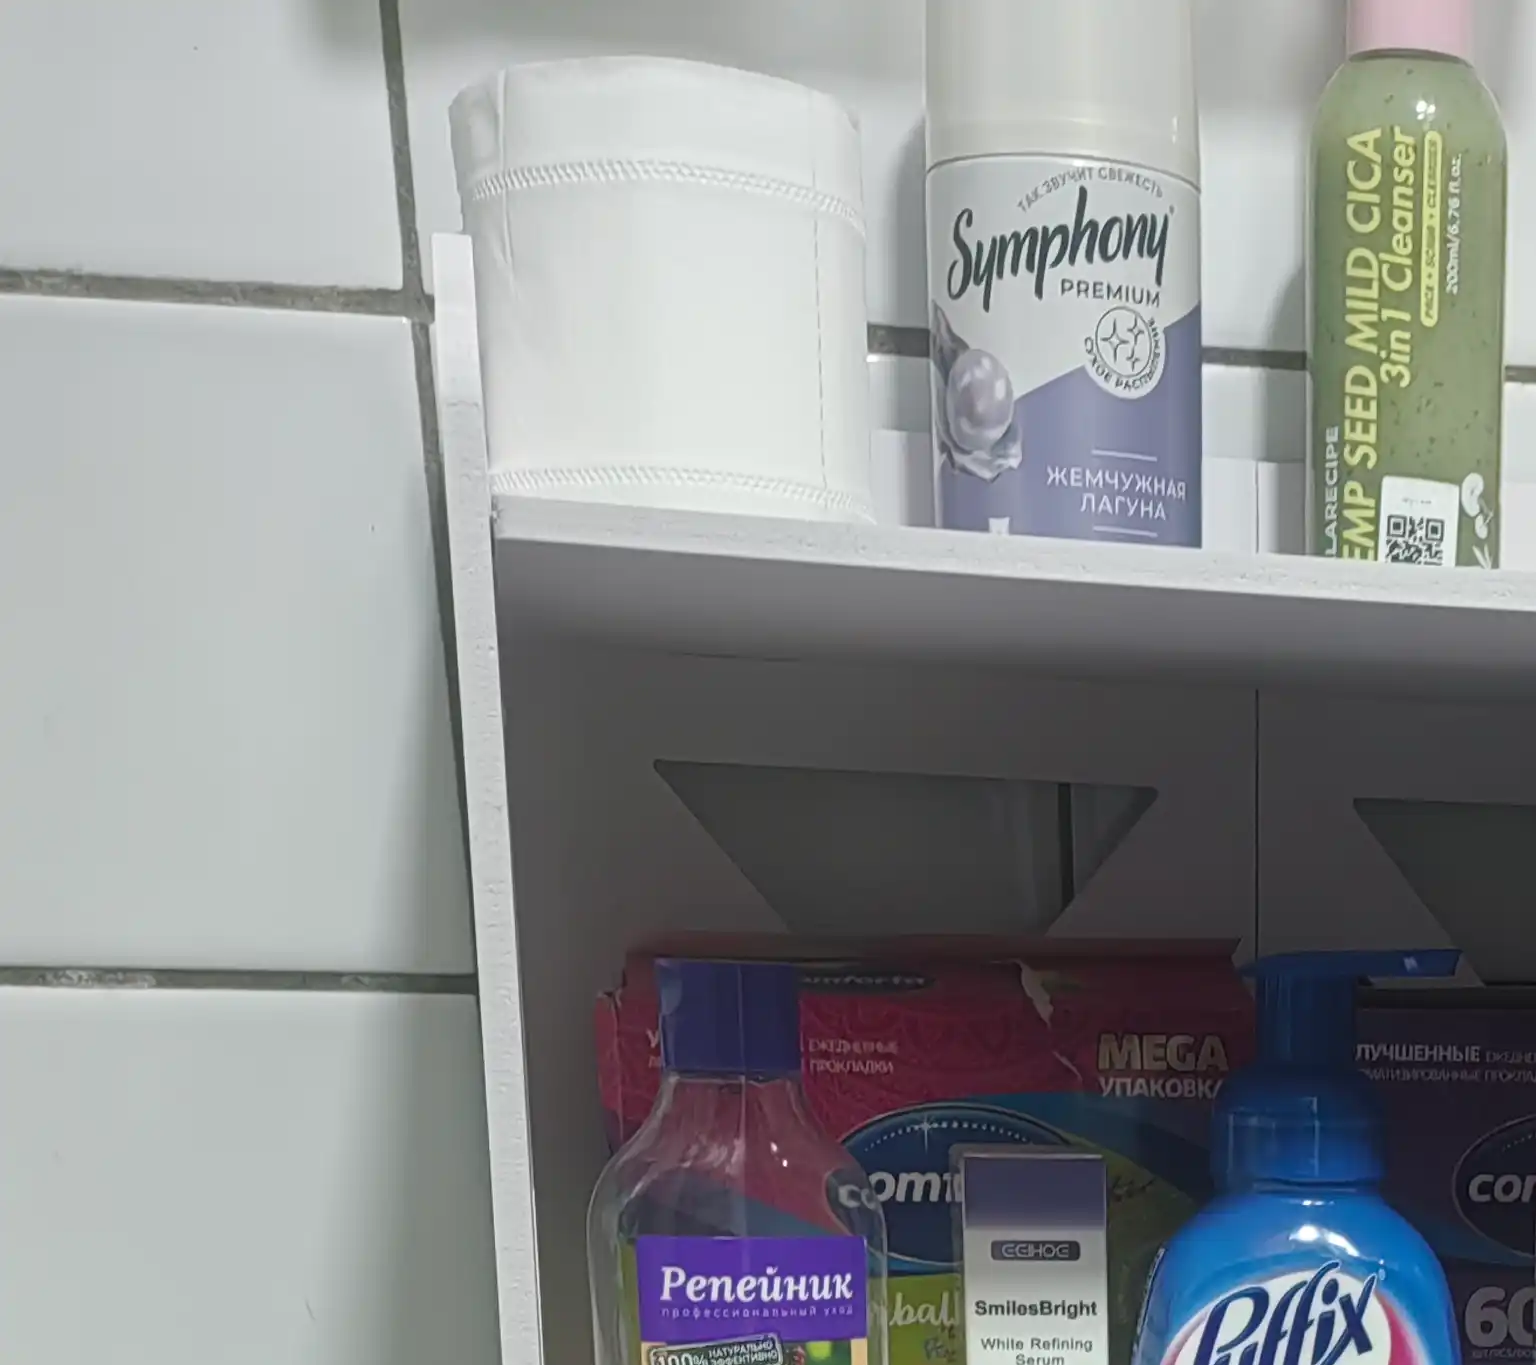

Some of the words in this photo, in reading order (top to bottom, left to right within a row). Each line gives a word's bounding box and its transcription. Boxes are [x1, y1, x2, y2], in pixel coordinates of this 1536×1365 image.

[1346, 127, 1383, 234] CICA
[1382, 126, 1417, 296] Cleanser
[946, 185, 1169, 313] Symphony
[1060, 278, 1161, 308] PREMIUM
[1344, 246, 1381, 361] MILD
[1380, 308, 1413, 388] 3in1
[1342, 364, 1379, 471] SEED
[1046, 465, 1187, 501] ЖЕМЧУЖНАЯ
[1080, 492, 1167, 521] ЛАГУНА
[1341, 480, 1377, 562] EMP
[809, 1058, 895, 1076] ПРОКЛАДКИ
[1097, 1032, 1231, 1074] MEGA
[1355, 1042, 1481, 1063] ЛУЧШЕННЫЕ
[659, 1265, 854, 1303] Репейник
[660, 1304, 818, 1322] профессиональный
[822, 1304, 855, 1318] уход
[974, 1299, 1098, 1321] SmilesBright
[980, 1337, 1025, 1351] White
[1030, 1337, 1094, 1354] Refining
